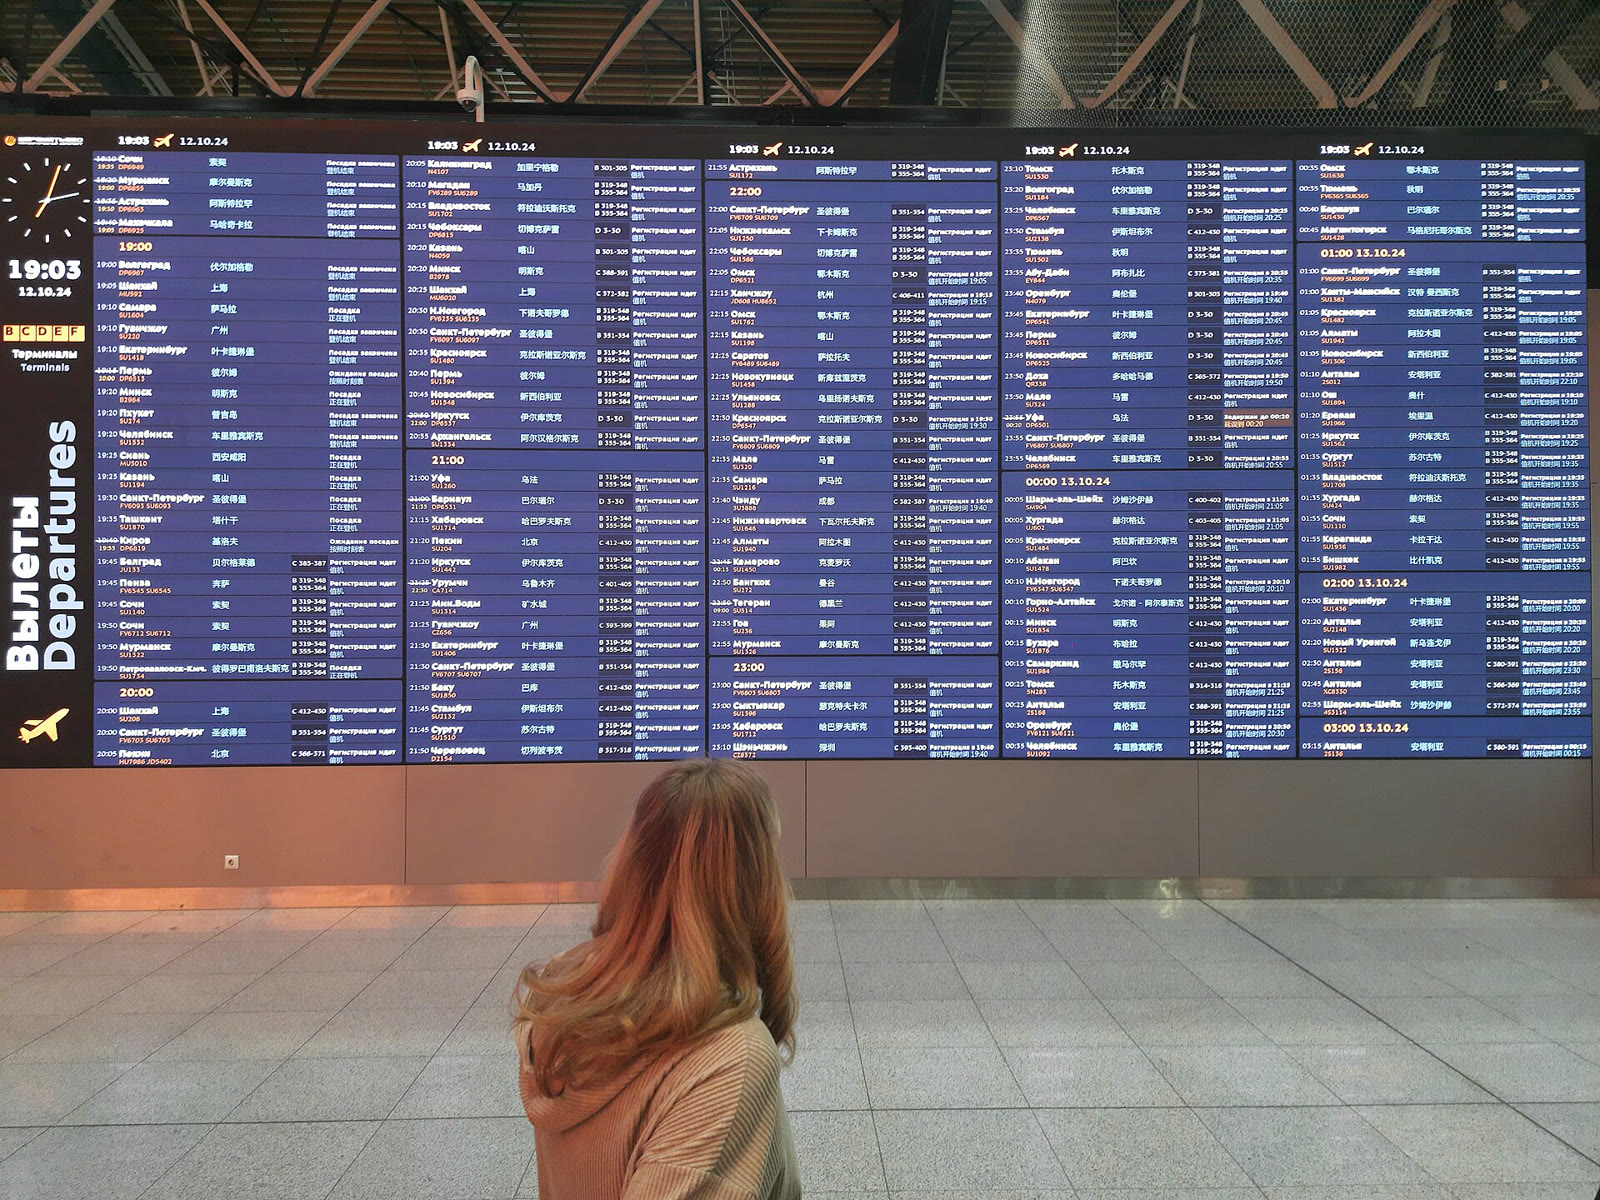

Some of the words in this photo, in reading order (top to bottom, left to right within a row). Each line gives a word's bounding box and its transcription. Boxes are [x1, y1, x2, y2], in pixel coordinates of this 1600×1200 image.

[179, 137, 228, 146] 12.10.24
[488, 142, 536, 151] 12.10.24
[787, 146, 834, 154] 12.10.24
[1083, 147, 1130, 155] 12.10.24
[1378, 146, 1424, 154] 12.10.24
[730, 187, 761, 196] 22:00
[119, 242, 152, 252] 19:00
[1321, 249, 1353, 258] 01:00
[1356, 249, 1406, 258] 13.10.24
[97, 261, 117, 269] 19:00
[9, 260, 81, 280] 19:03
[97, 282, 117, 290] 19:05
[211, 283, 228, 293] 上海
[18, 287, 71, 297] 12.10.24
[97, 303, 117, 311] 19:10
[6, 326, 13, 335] B
[22, 326, 30, 336] C
[38, 326, 47, 335] D
[55, 326, 62, 335] E
[71, 326, 78, 335] F
[12, 349, 78, 359] Терминалы
[21, 363, 69, 372] Terminals
[97, 388, 117, 396] 19:20
[431, 456, 464, 465] 21:00
[1026, 478, 1057, 486] 00:00
[1061, 478, 1110, 486] 13.10.24
[120, 536, 151, 544] Киров
[43, 421, 84, 671] Departures
[6, 497, 39, 671] Вылеты
[1323, 579, 1355, 588] 02:00
[1358, 579, 1408, 587] 13.10.24
[120, 600, 144, 608] Сочи
[521, 621, 538, 629] 广州
[733, 663, 765, 672] 23:00
[120, 688, 154, 697] 20:00
[1323, 724, 1356, 733] 03:00
[1359, 724, 1409, 733] 13.10.24
[211, 749, 229, 758] 北京
